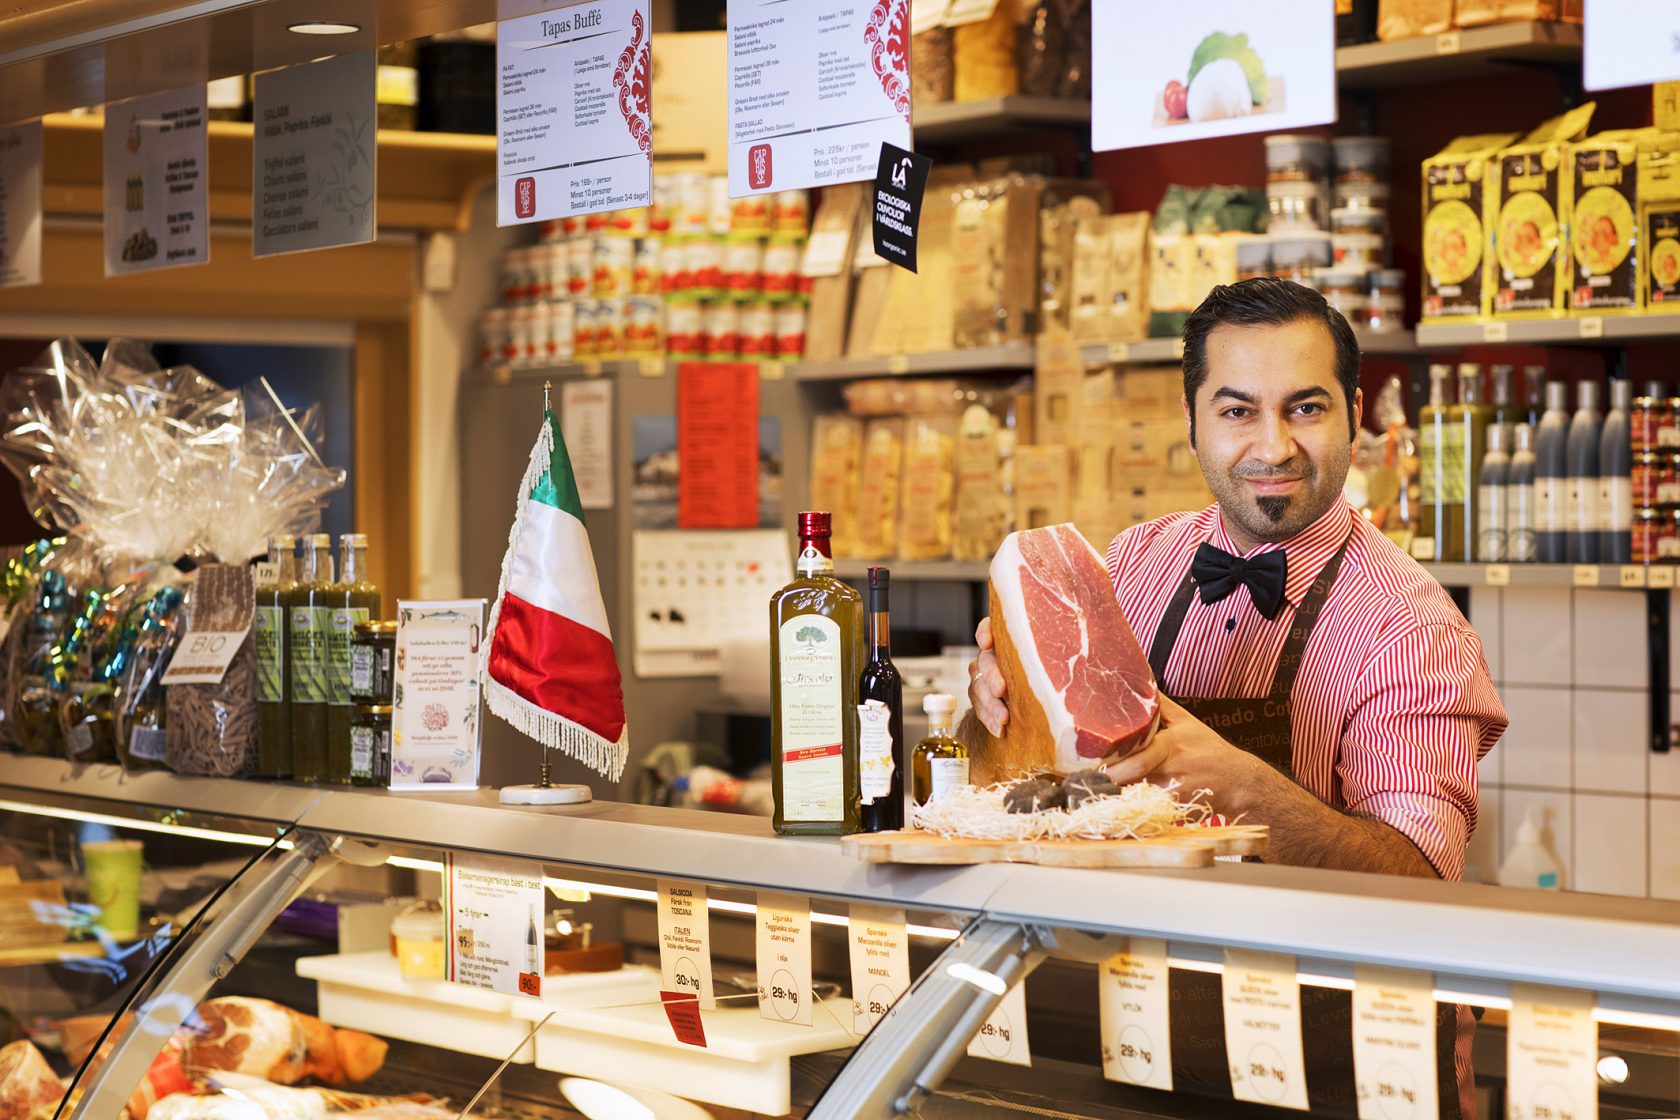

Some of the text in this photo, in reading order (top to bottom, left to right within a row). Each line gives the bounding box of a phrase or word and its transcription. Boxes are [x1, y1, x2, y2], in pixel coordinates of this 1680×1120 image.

[541, 9, 603, 38] Tapas Buffé
[264, 105, 290, 120] SALAMI
[310, 112, 332, 128] Fänkål
[828, 146, 846, 154] 225kr
[850, 142, 870, 153] person
[285, 152, 305, 167] salami
[814, 155, 863, 168] Minst 10 personer
[264, 170, 307, 188] Chianti salami
[836, 168, 846, 178] god
[597, 176, 612, 185] person
[264, 186, 309, 204] Chorizo salami
[570, 186, 612, 198] Minst 10 personer
[570, 199, 586, 210] Beställ
[590, 198, 598, 208] god
[625, 193, 634, 202] 3-4
[634, 190, 650, 202] dagar)
[878, 190, 911, 213] EKOLOGISKA
[284, 205, 304, 218] salami
[876, 202, 905, 222] OLIVOLJOR
[298, 217, 319, 232] salami
[191, 635, 226, 654] BIO
[511, 878, 524, 888] bäst
[528, 881, 541, 890] test
[670, 888, 693, 898] SALSICCIA
[670, 898, 692, 906] Färsk från
[671, 907, 692, 916] TOSCANA
[674, 926, 690, 936] ITALIEN
[866, 928, 888, 937] Spanska
[782, 934, 795, 943] kärna
[858, 936, 897, 948] Manzanilla oliver
[780, 954, 788, 962] olja
[866, 948, 879, 958] fyllda
[868, 968, 893, 978] MANDEL
[522, 978, 537, 990] 90:-
[676, 974, 700, 990] 30:- hg
[772, 986, 798, 1004] 29:- hg
[870, 1002, 886, 1015] 29:-
[998, 1026, 1010, 1042] hg
[1120, 1043, 1152, 1065] 29:- hg
[1272, 1066, 1286, 1084] hg
[1400, 1087, 1416, 1106] hg
